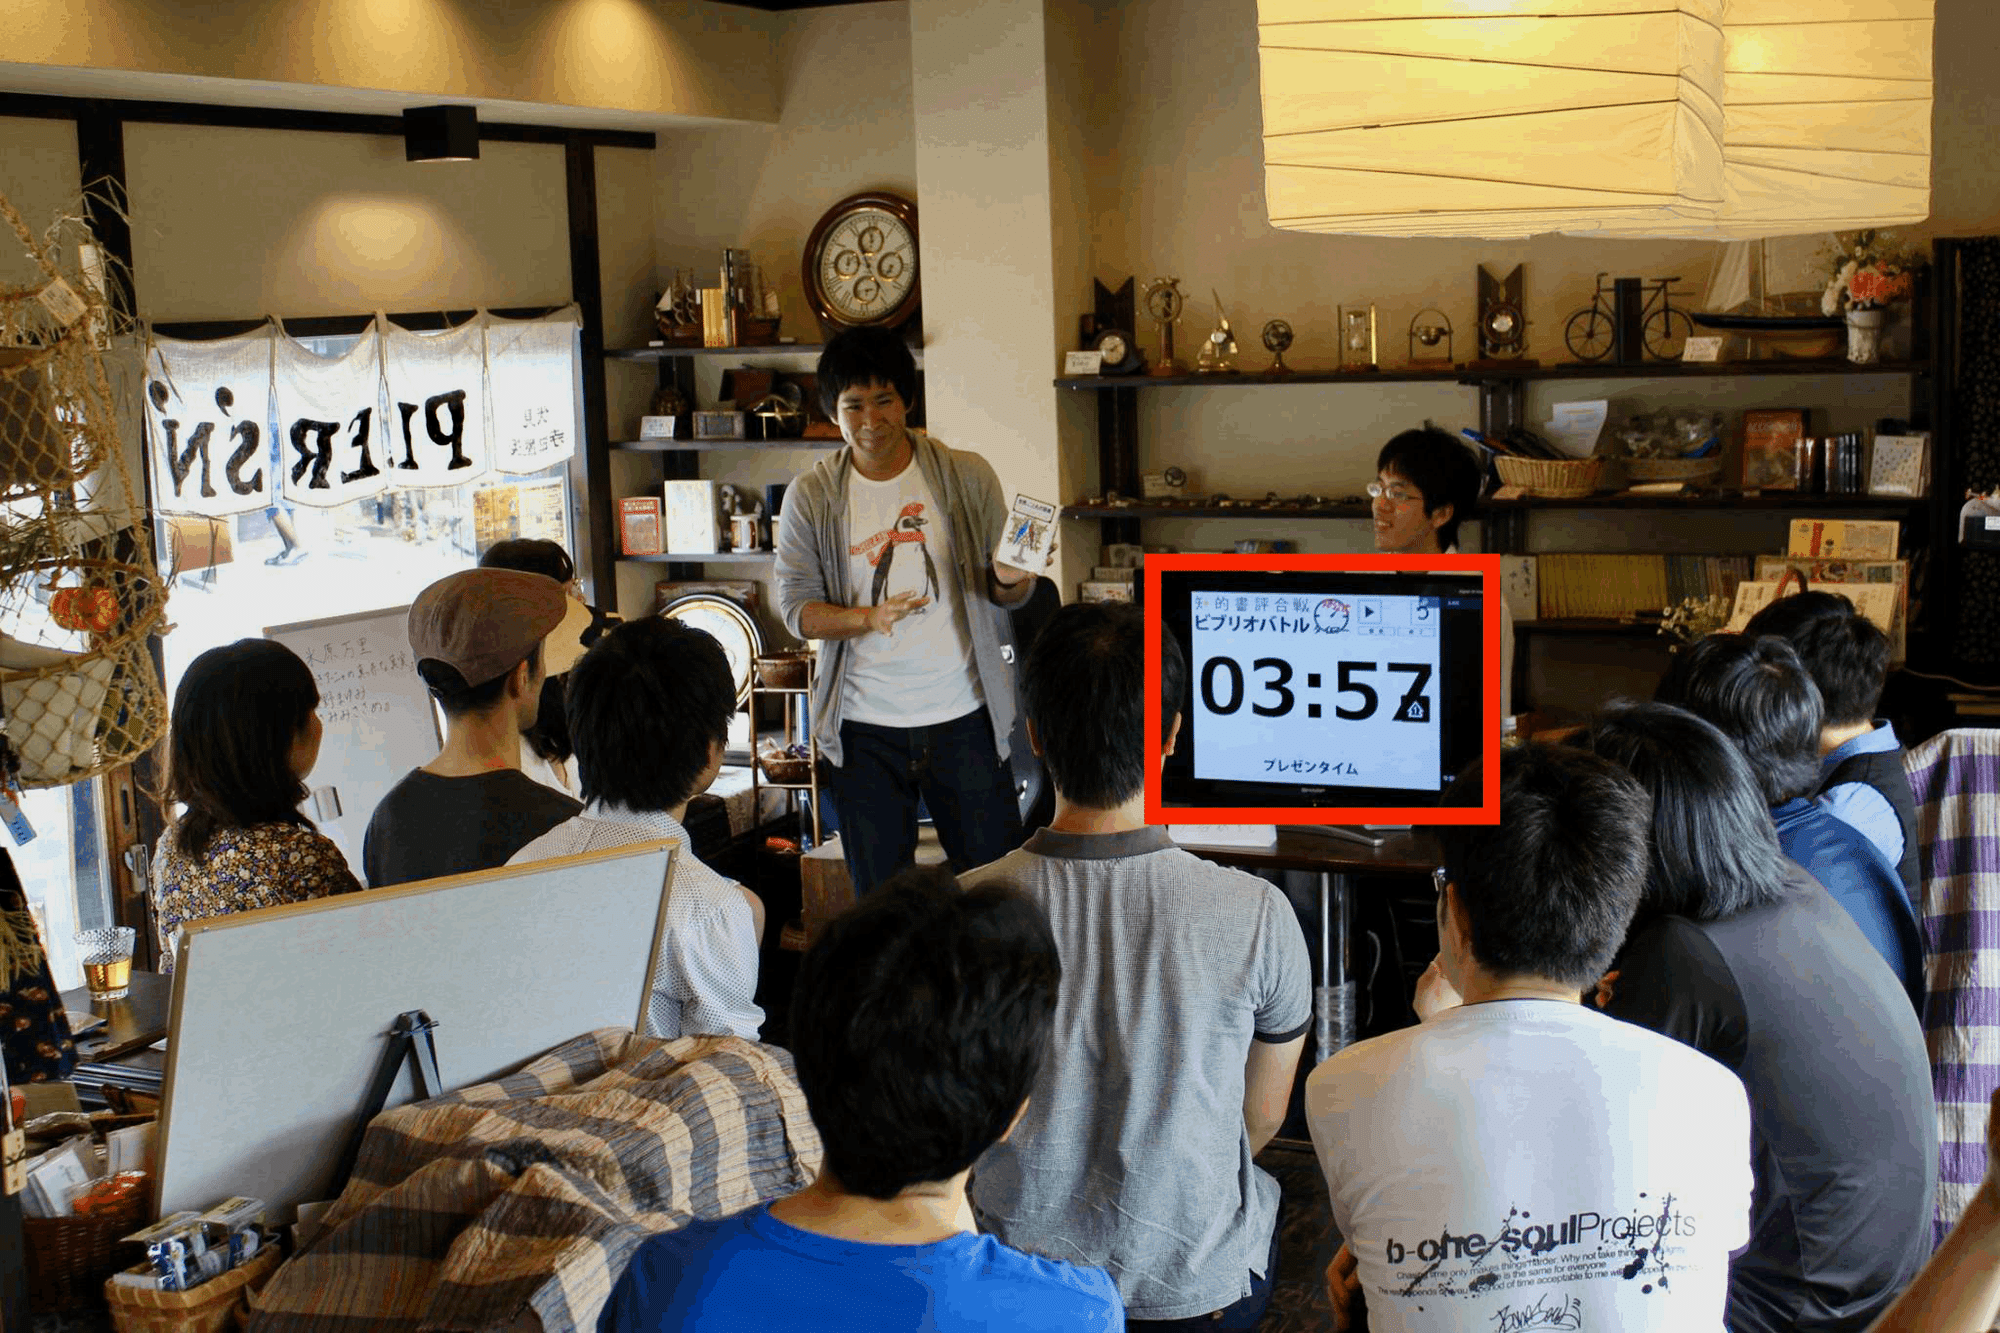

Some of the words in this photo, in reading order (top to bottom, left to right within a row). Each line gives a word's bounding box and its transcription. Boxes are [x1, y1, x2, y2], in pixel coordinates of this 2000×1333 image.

[1194, 614, 1311, 635] ビブリオバトル
[1200, 655, 1433, 722] 03:57
[1263, 758, 1359, 776] プレゼンタイム
[1560, 1252, 1581, 1264] Why
[1582, 1251, 1597, 1261] not
[1598, 1249, 1616, 1259] take
[1512, 1270, 1527, 1279] the
[1528, 1267, 1553, 1276] same
[1554, 1264, 1566, 1273] for
[1567, 1260, 1607, 1272] everyone
[1516, 1278, 1535, 1288] time
[1536, 1273, 1583, 1285] acceptable
[1584, 1271, 1593, 1280] to
[1594, 1270, 1609, 1279] me
